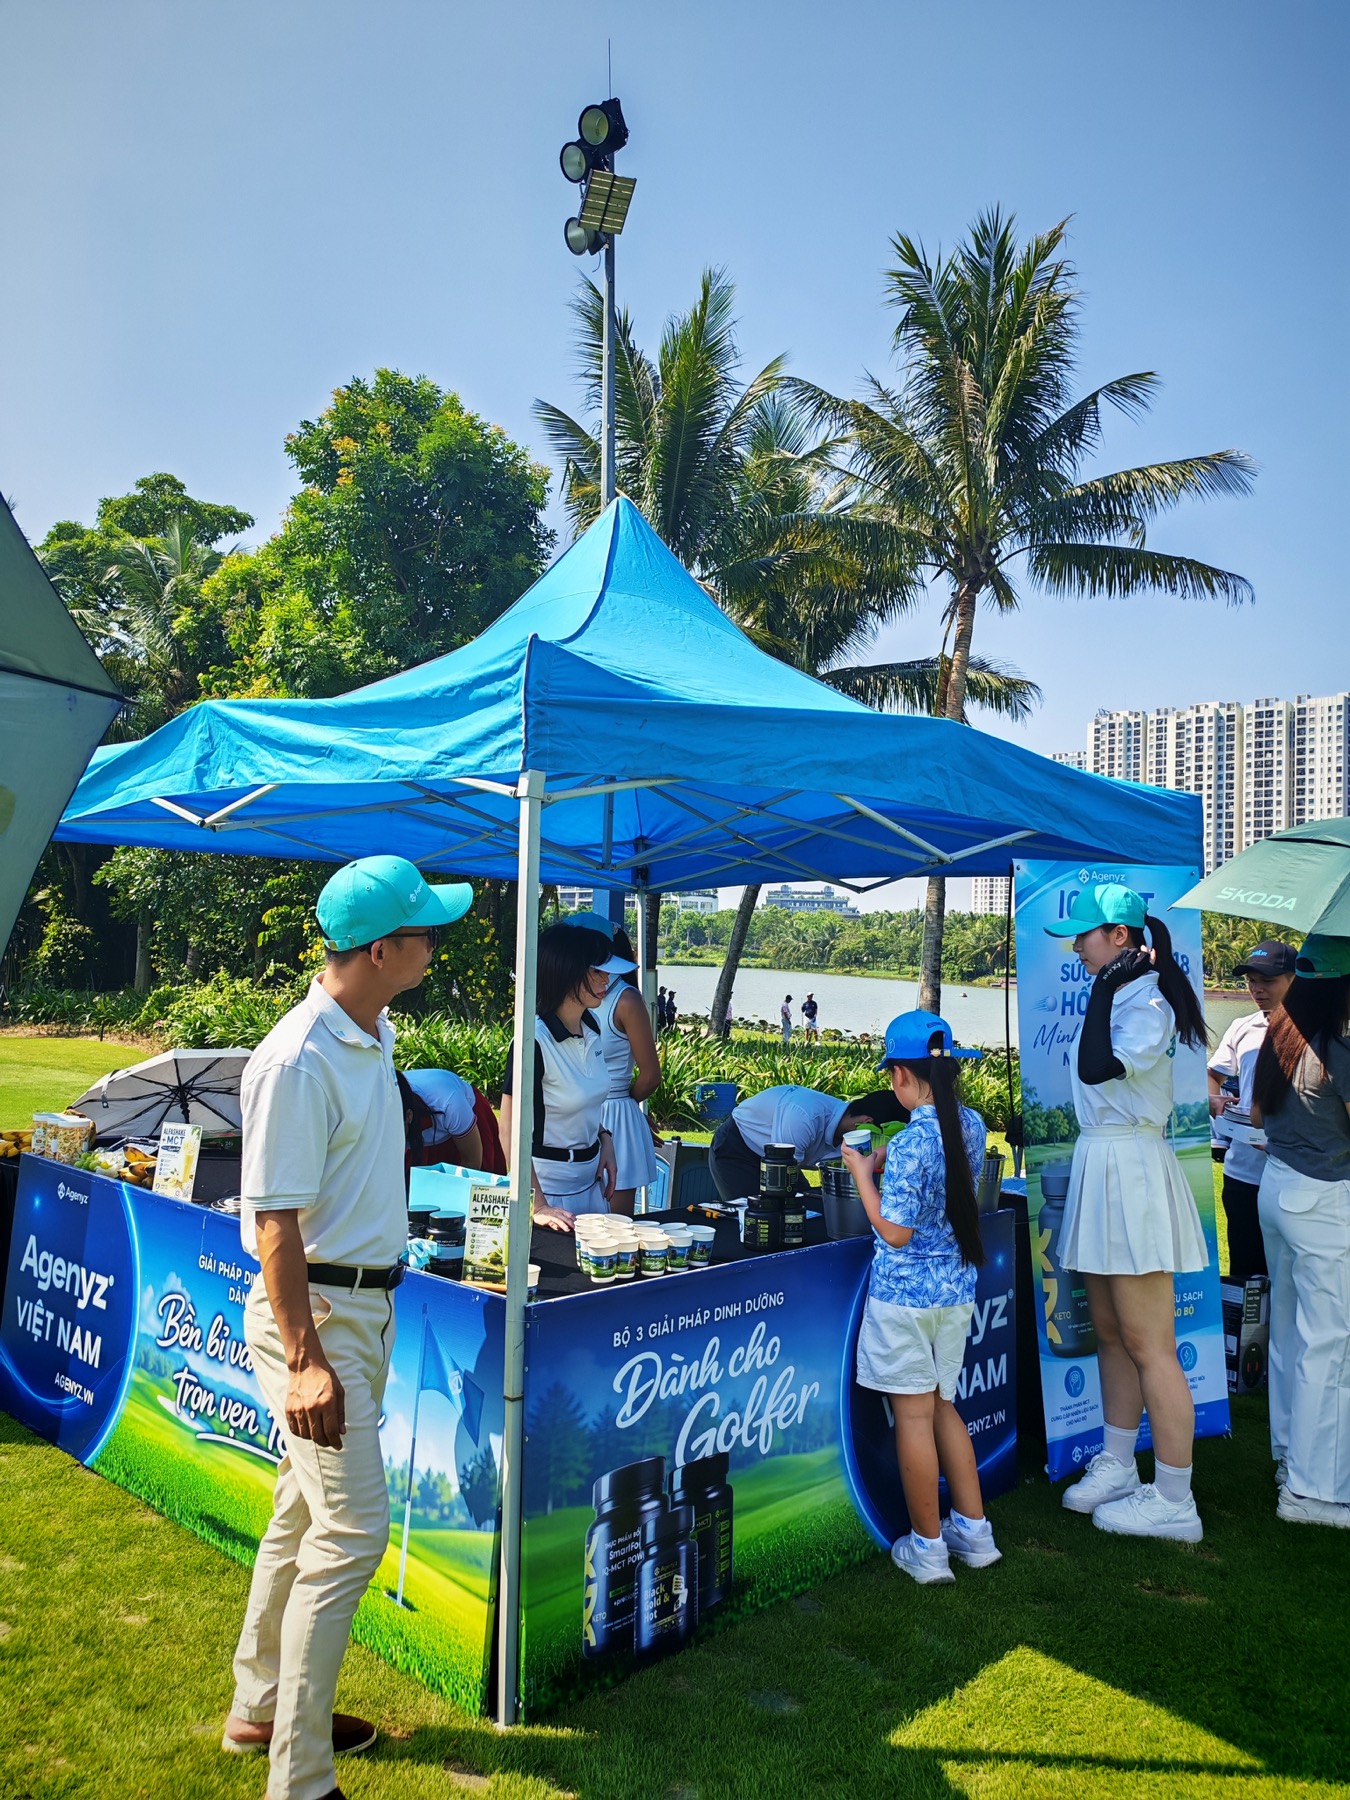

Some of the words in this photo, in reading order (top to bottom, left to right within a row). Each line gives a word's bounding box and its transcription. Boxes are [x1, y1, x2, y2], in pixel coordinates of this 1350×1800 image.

[1091, 870, 1126, 882] Agenyz
[166, 1136, 185, 1146] MCT
[65, 1186, 89, 1205] Agenyz
[472, 1193, 510, 1205] ALFASHAKE
[481, 1204, 509, 1217] MCT
[198, 1252, 217, 1273] GIẢI
[218, 1261, 242, 1283] PHÁP
[1182, 1290, 1204, 1304] SẠCH
[156, 1293, 203, 1352] Bền
[613, 1326, 631, 1348] BỘ
[635, 1326, 644, 1342] 3
[648, 1314, 675, 1338] GIẢI
[678, 1308, 710, 1331] PHÁP
[714, 1302, 742, 1322] DINH
[745, 1292, 785, 1315] DƯỠNG
[1053, 1310, 1072, 1320] KETO
[16, 1294, 55, 1343] VIỆT
[56, 1316, 102, 1369] NAM
[728, 1321, 781, 1378] cho
[54, 1371, 94, 1406] AGENYZ.VN
[219, 1396, 259, 1438] vẹn
[674, 1365, 820, 1468] Golfer
[967, 1409, 1006, 1437] ENYZ.VN
[1083, 1441, 1104, 1457] Agen
[609, 1540, 641, 1561] SmartFo
[626, 1551, 645, 1568] POW
[643, 1582, 666, 1600] Black
[643, 1592, 661, 1613] Gold
[663, 1592, 671, 1603] &
[591, 1611, 607, 1624] KETO
[643, 1609, 659, 1624] Hot
